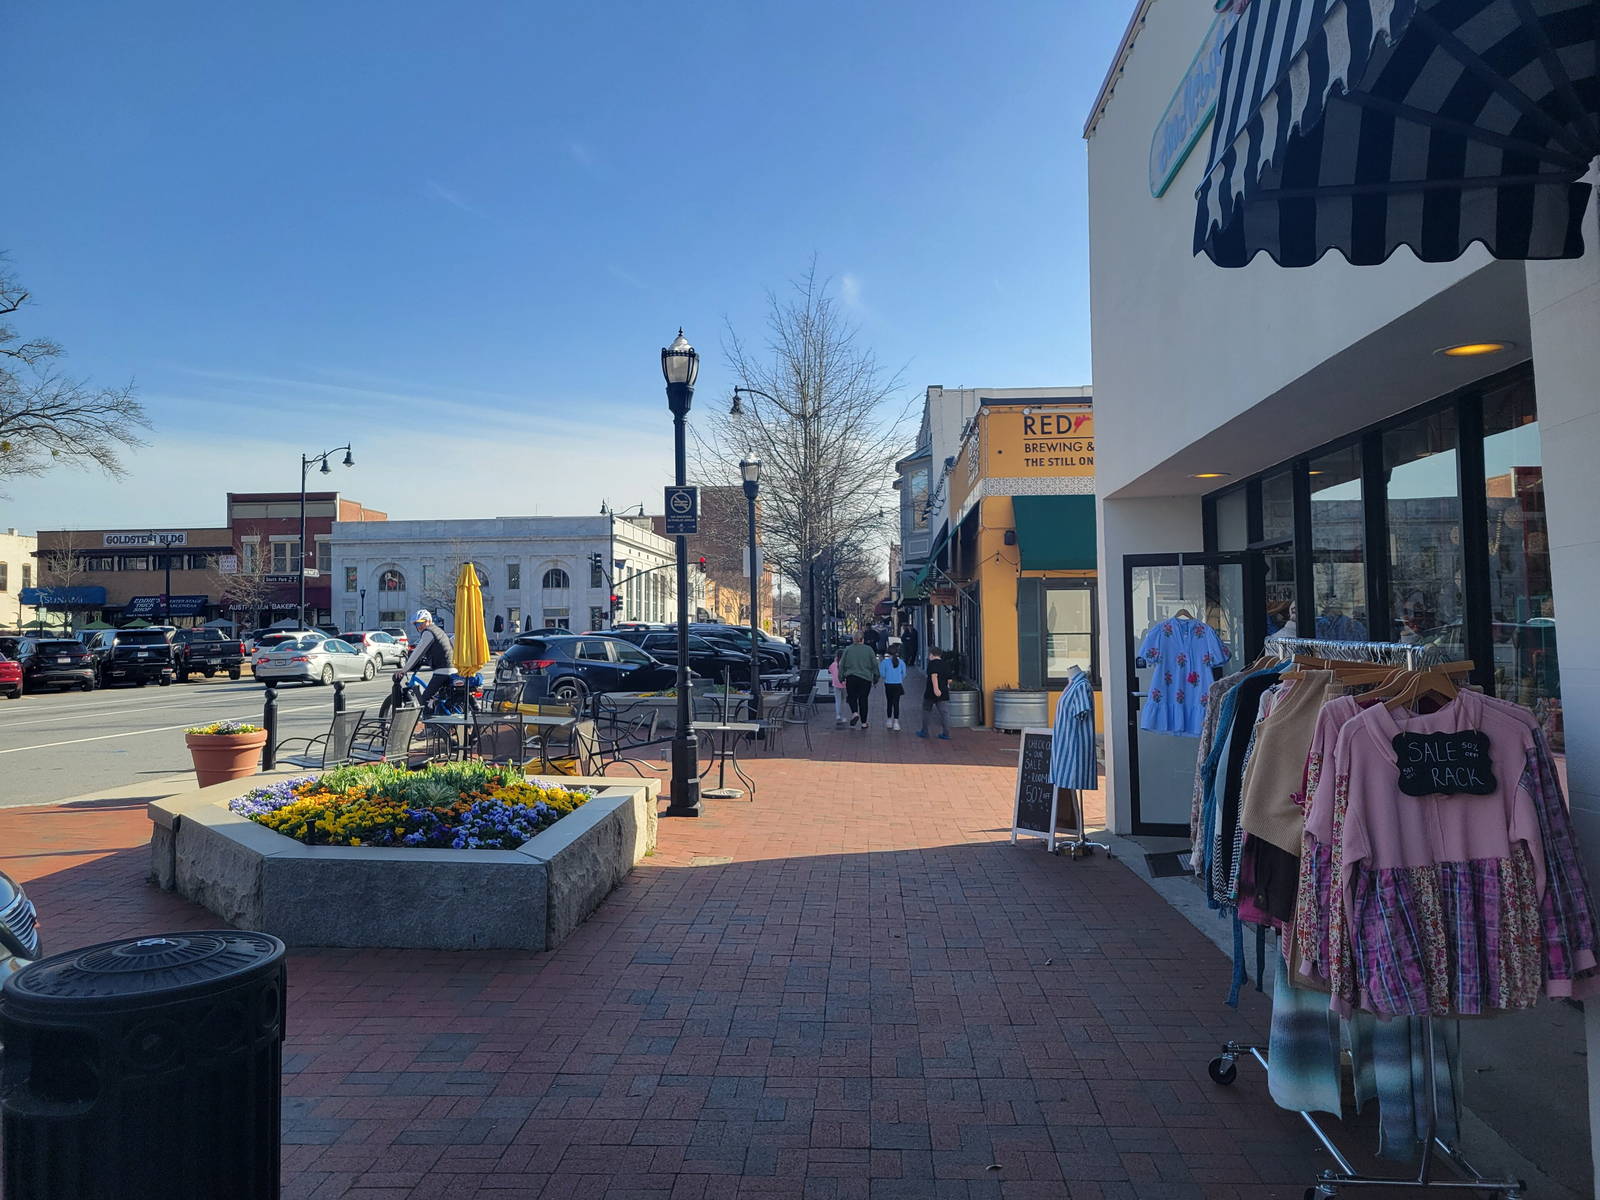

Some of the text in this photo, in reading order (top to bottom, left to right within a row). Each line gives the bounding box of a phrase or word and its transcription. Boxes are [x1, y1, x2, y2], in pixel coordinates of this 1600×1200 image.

[1024, 415, 1072, 435] RED
[1024, 441, 1095, 453] BREWING &
[1025, 456, 1094, 467] THE STILL ON
[159, 534, 184, 543] BLDG
[1408, 741, 1458, 763] SALE
[1024, 759, 1041, 770] SALE
[1431, 767, 1485, 788] RACK
